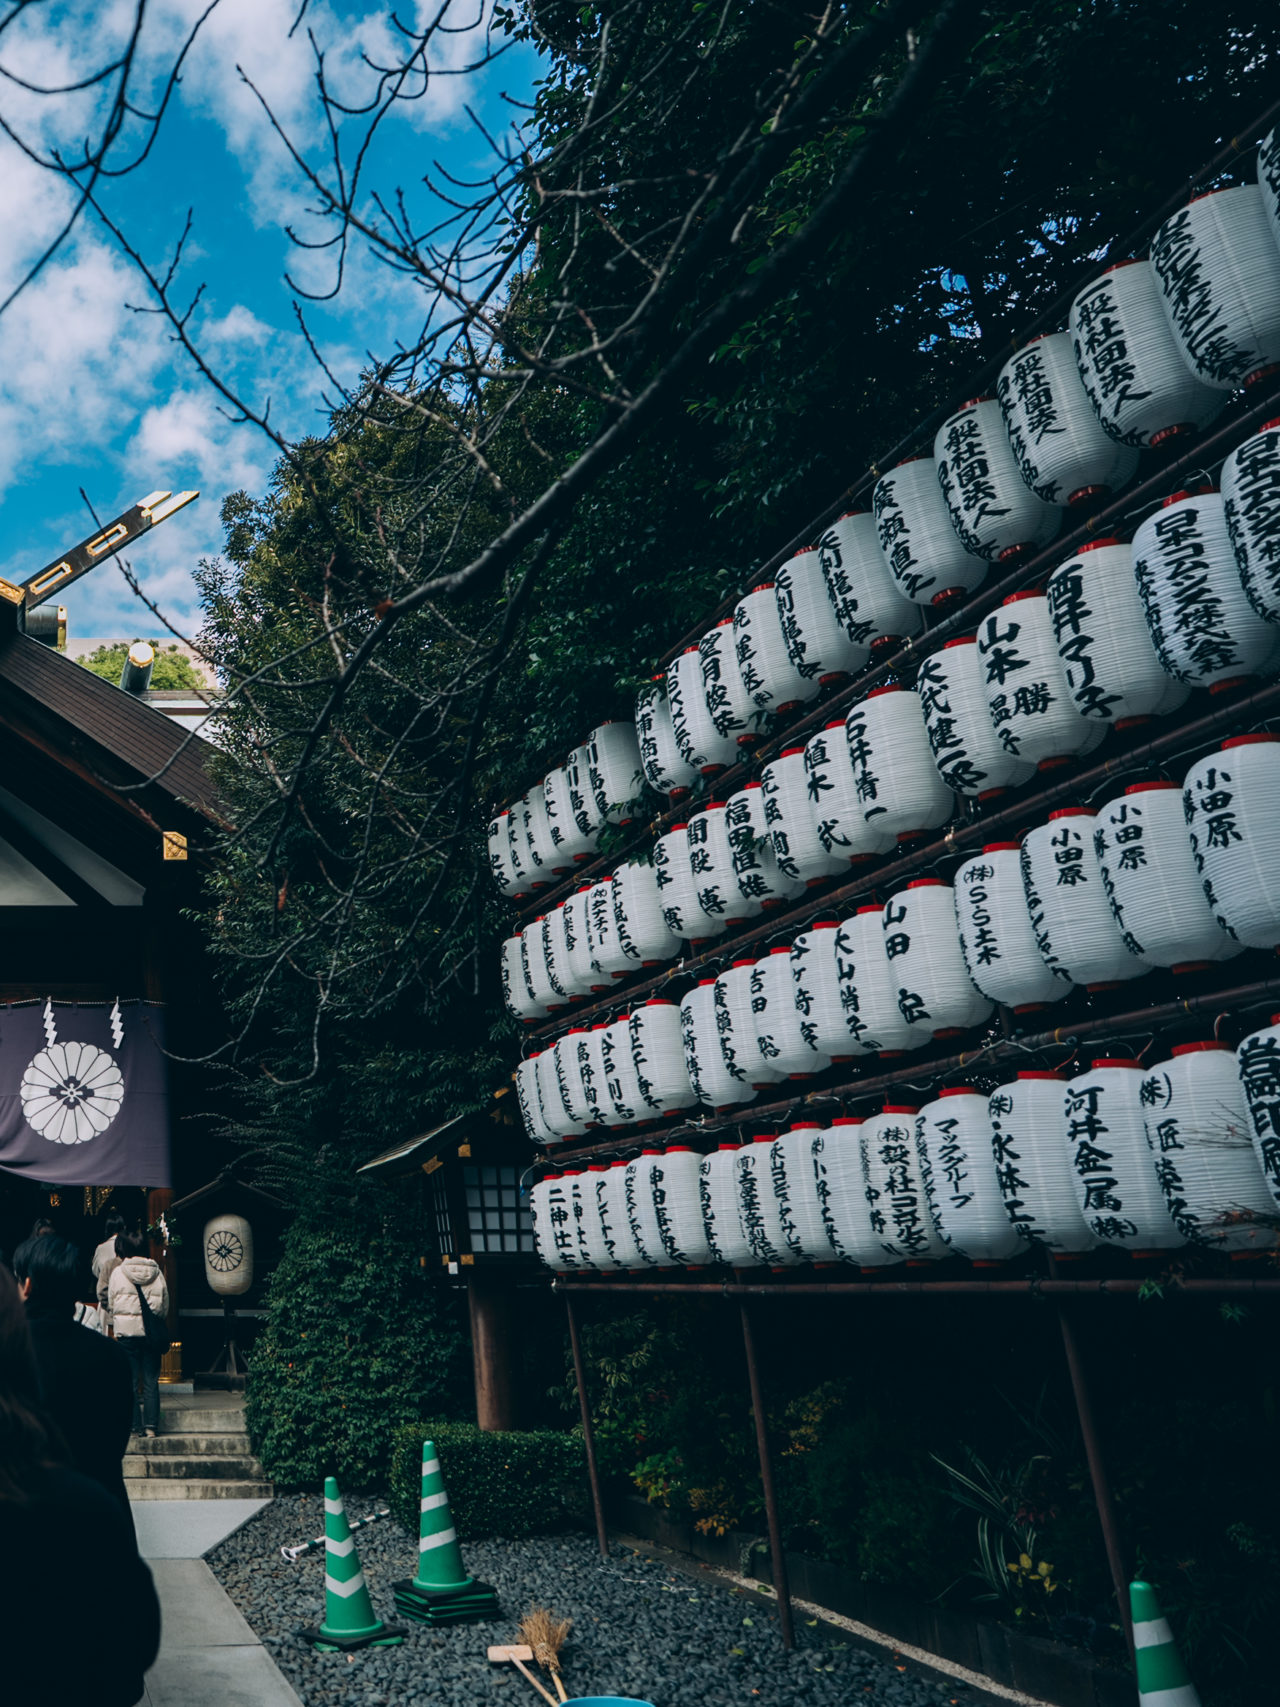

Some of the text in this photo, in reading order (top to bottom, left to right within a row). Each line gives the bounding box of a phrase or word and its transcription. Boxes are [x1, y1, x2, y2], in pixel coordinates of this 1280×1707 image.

[1011, 346, 1066, 445] 一般社団法人
[1076, 279, 1152, 417] 一般社団法人
[946, 409, 1012, 529] 一般社団法人
[1047, 564, 1123, 718] 酒井マリ子
[1155, 508, 1245, 676] 日本コムシス株式会社
[1051, 828, 1088, 886] 小田原
[1110, 804, 1148, 870] 小田原
[1196, 768, 1243, 848] 小田原
[934, 1118, 975, 1209] マックグループ
[1064, 1086, 1138, 1239] 河井金属(株)
